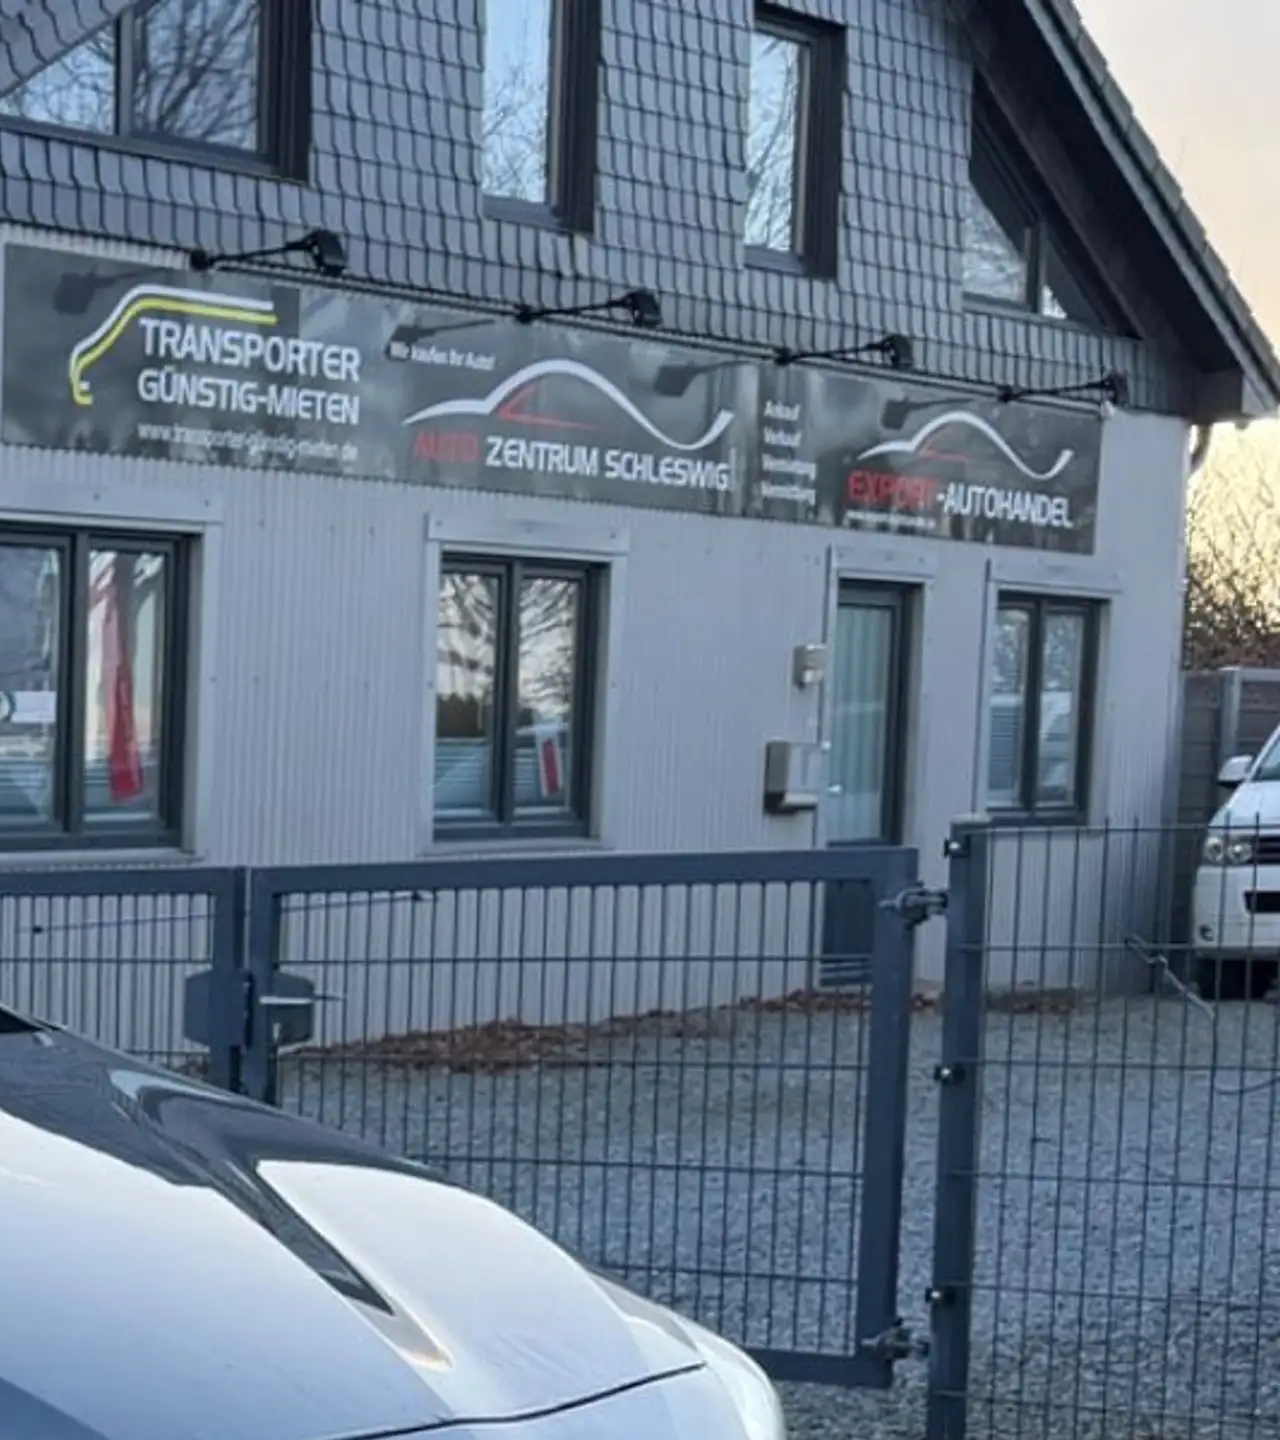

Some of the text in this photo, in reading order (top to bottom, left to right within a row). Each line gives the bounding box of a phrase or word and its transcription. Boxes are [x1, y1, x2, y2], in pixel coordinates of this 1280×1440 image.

[139, 317, 361, 382] TRANSPORTER
[138, 365, 359, 425] GÜNSTIG-MIETEN
[413, 426, 478, 463] AUTO
[485, 435, 598, 477] ZENTRUM
[605, 449, 730, 491] SCHLESWIG
